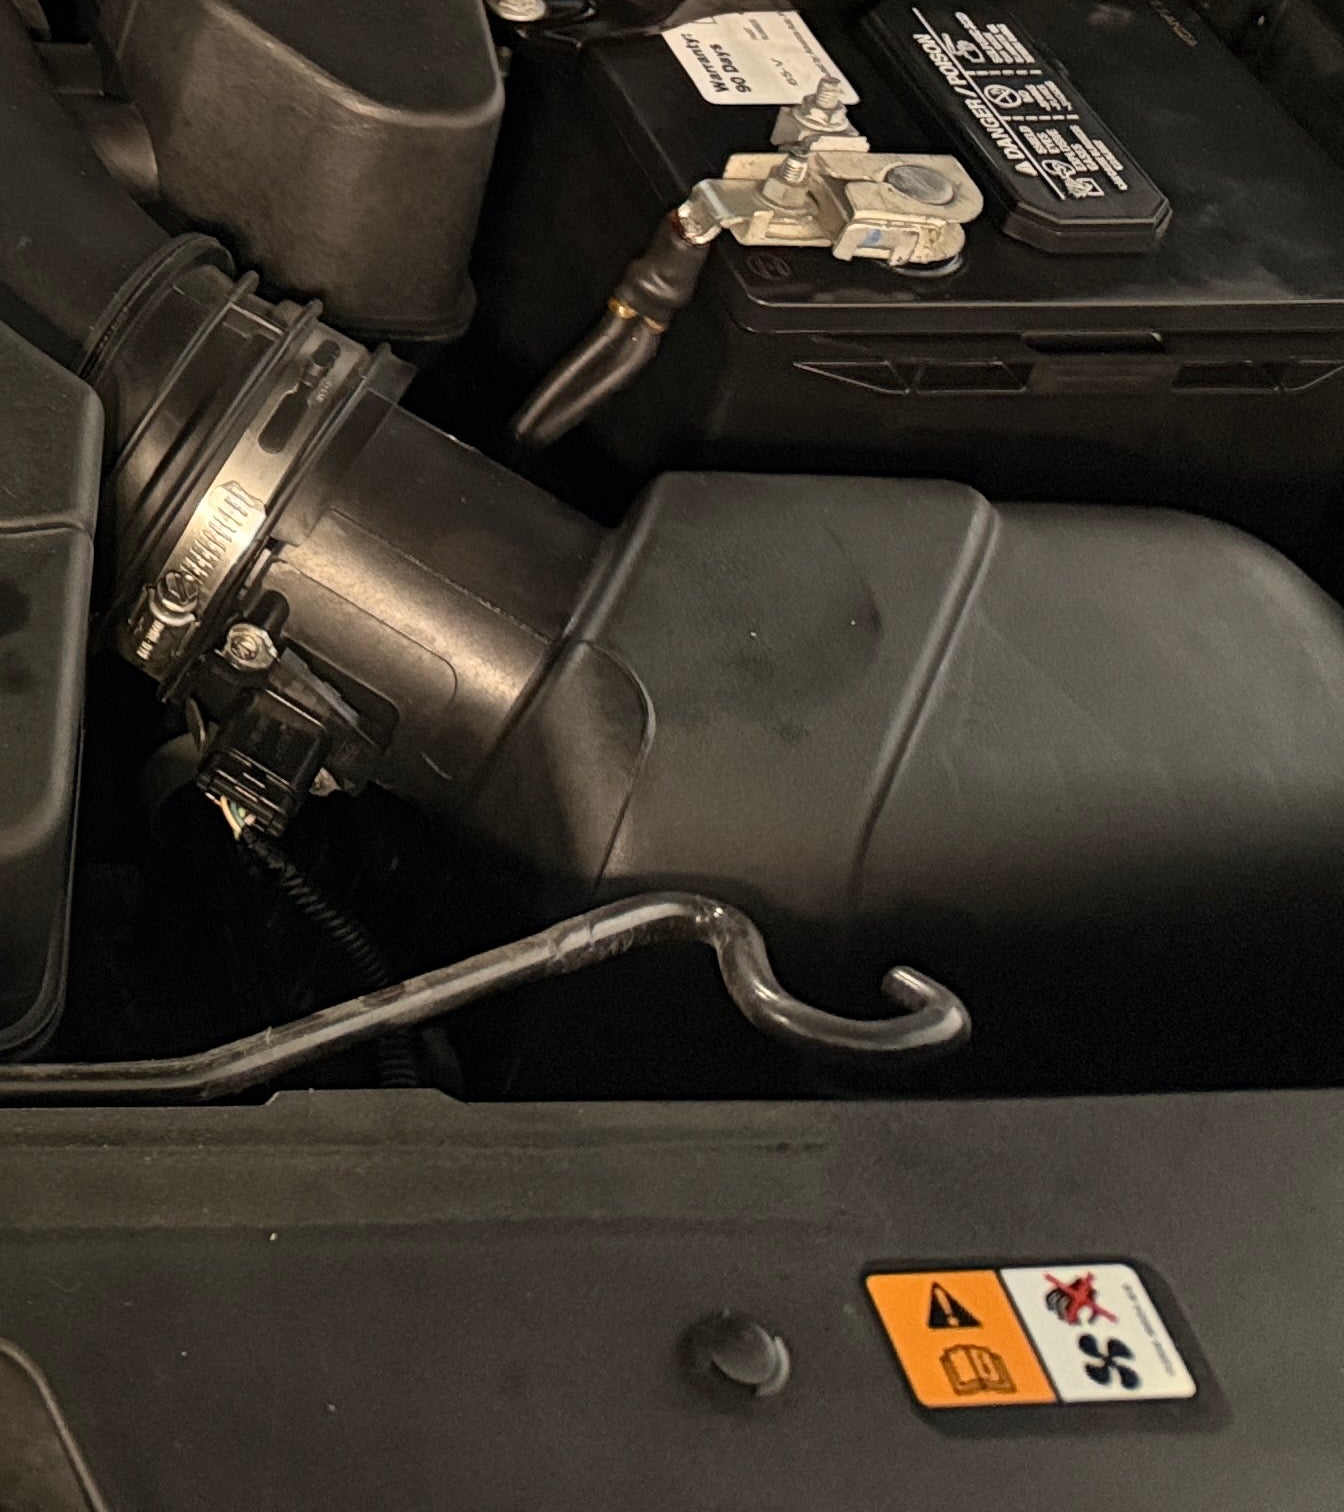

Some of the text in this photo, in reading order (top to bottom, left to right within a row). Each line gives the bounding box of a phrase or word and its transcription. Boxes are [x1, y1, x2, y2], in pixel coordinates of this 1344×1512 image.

[681, 33, 729, 94] Warranty:
[709, 43, 752, 94] 90 Days
[912, 33, 968, 86] POISON
[964, 99, 1026, 161] DANGER
[1036, 131, 1061, 155] EYES
